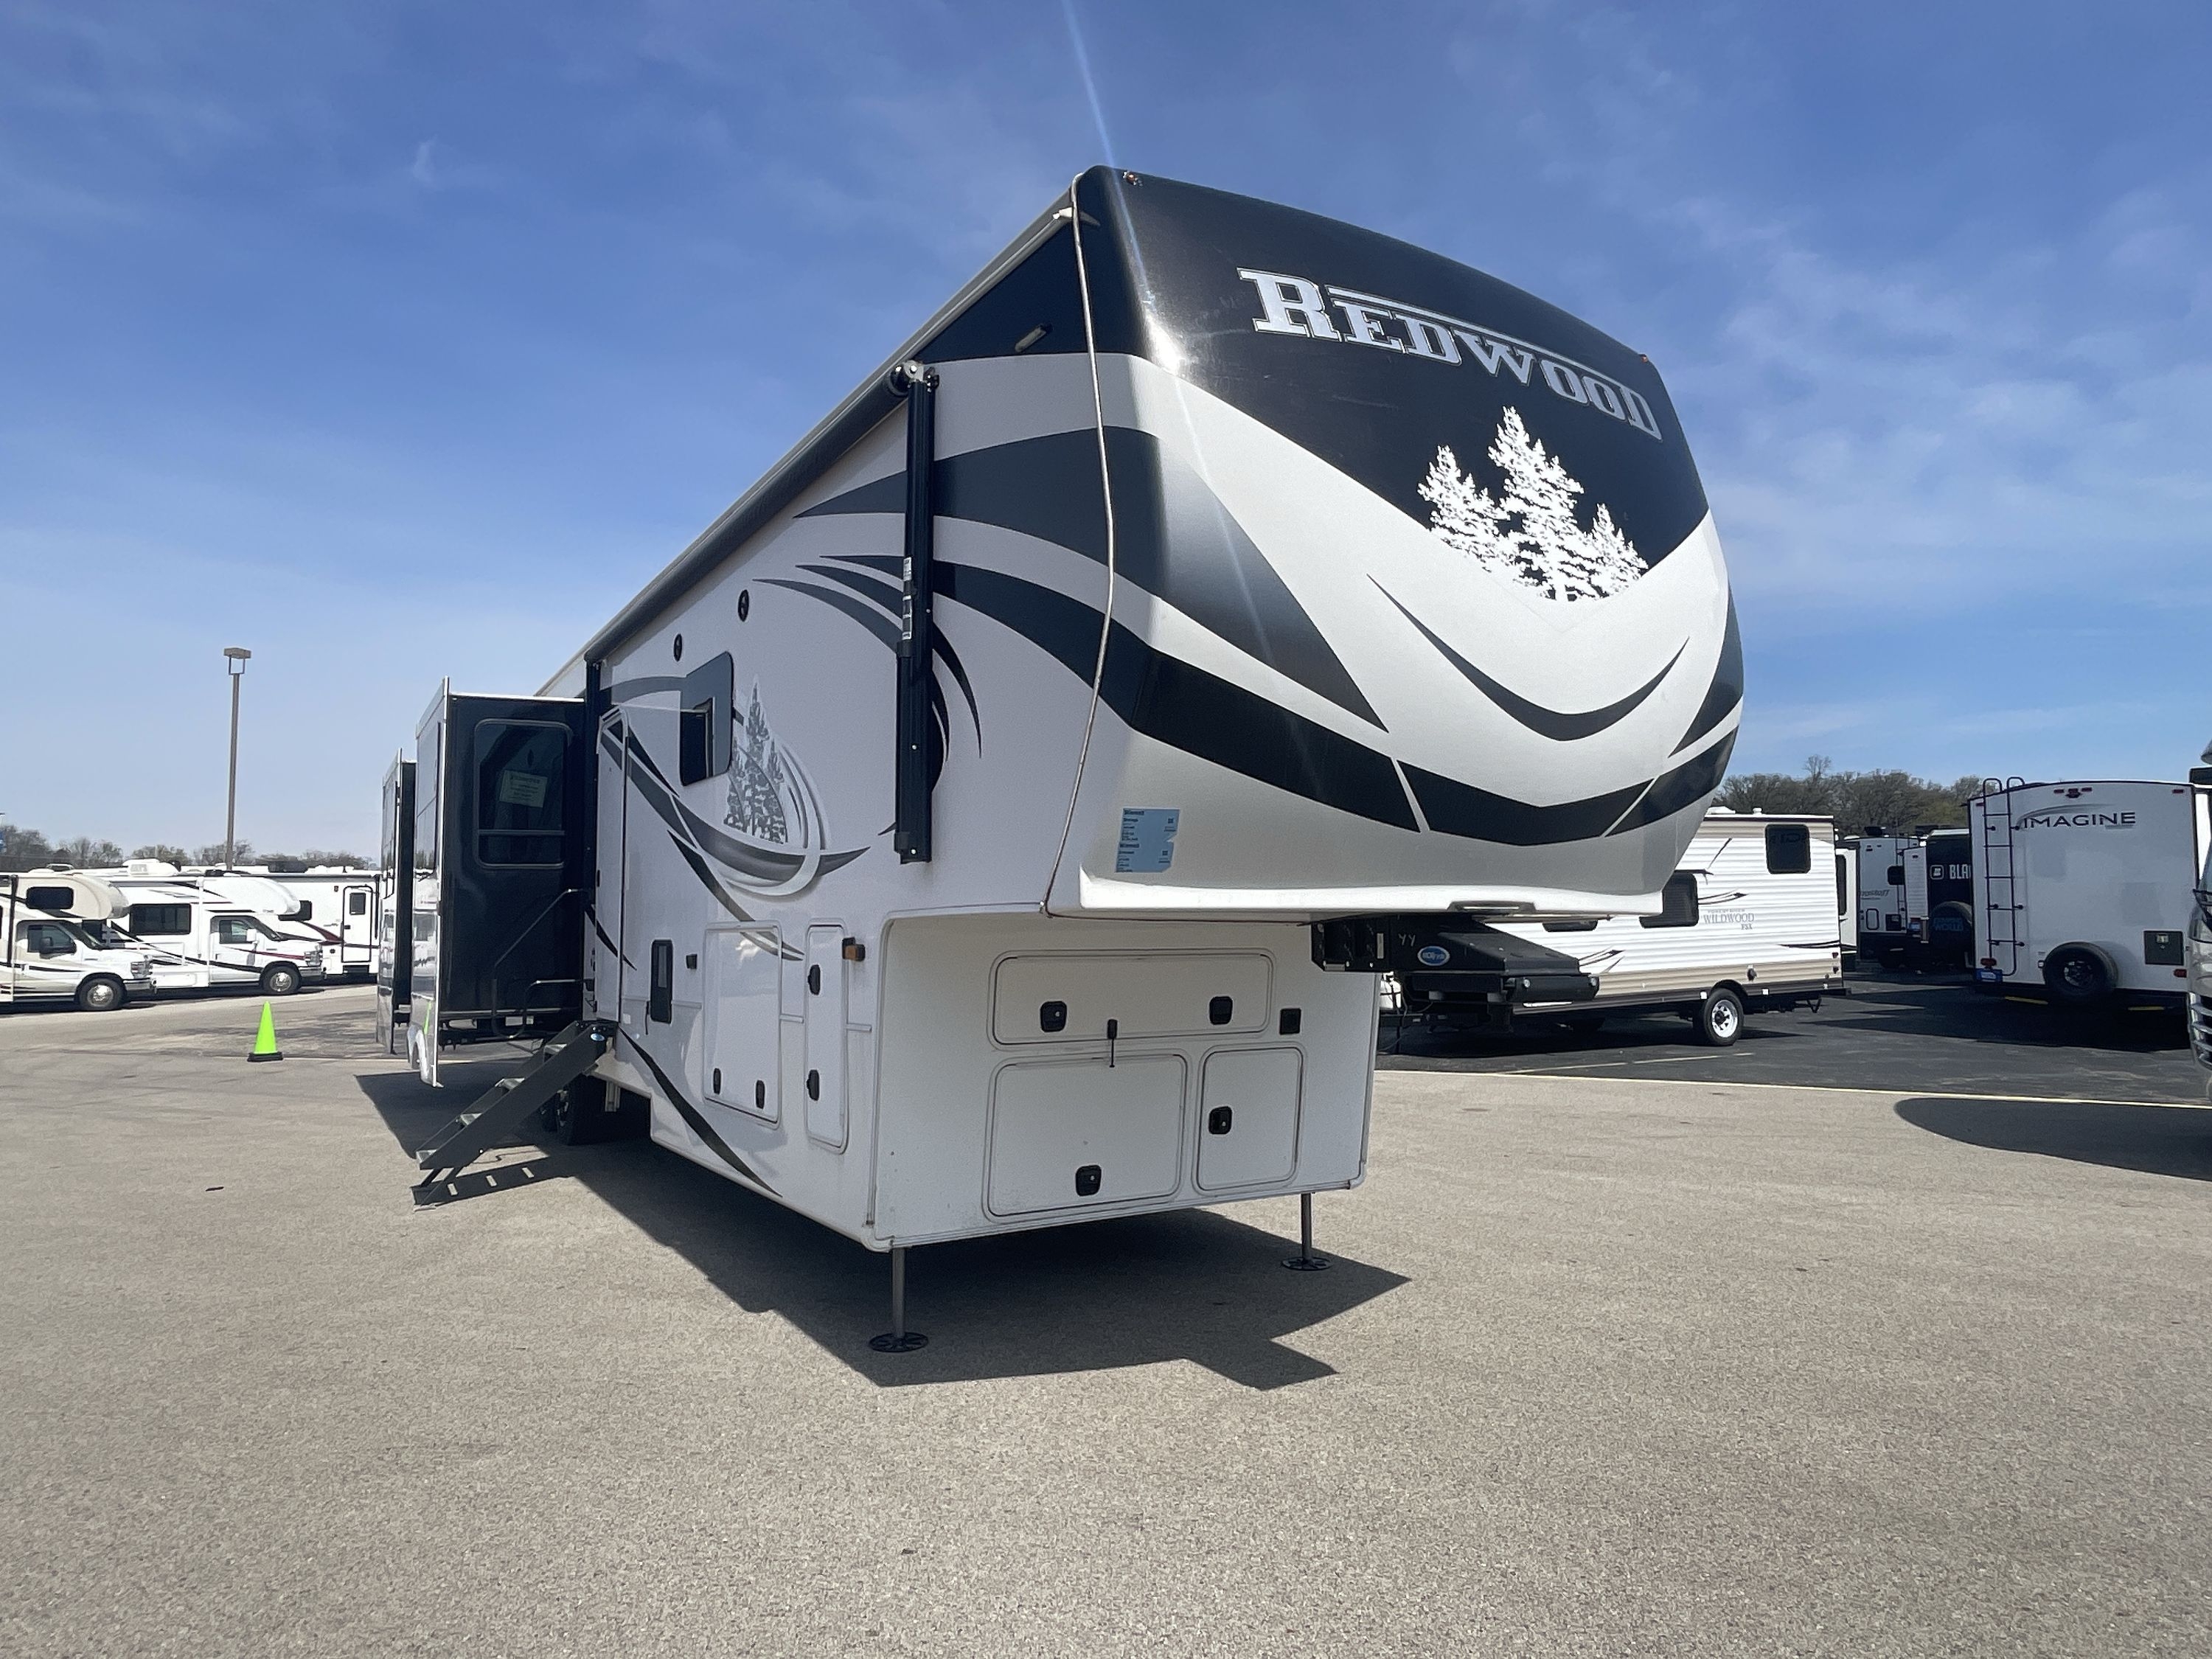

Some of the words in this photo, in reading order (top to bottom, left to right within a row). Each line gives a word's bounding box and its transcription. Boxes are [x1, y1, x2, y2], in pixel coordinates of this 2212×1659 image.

[1237, 267, 1663, 441] REDWOOD
[2024, 812, 2136, 829] IMAGINE
[1703, 913, 1754, 924] WILDWOOD
